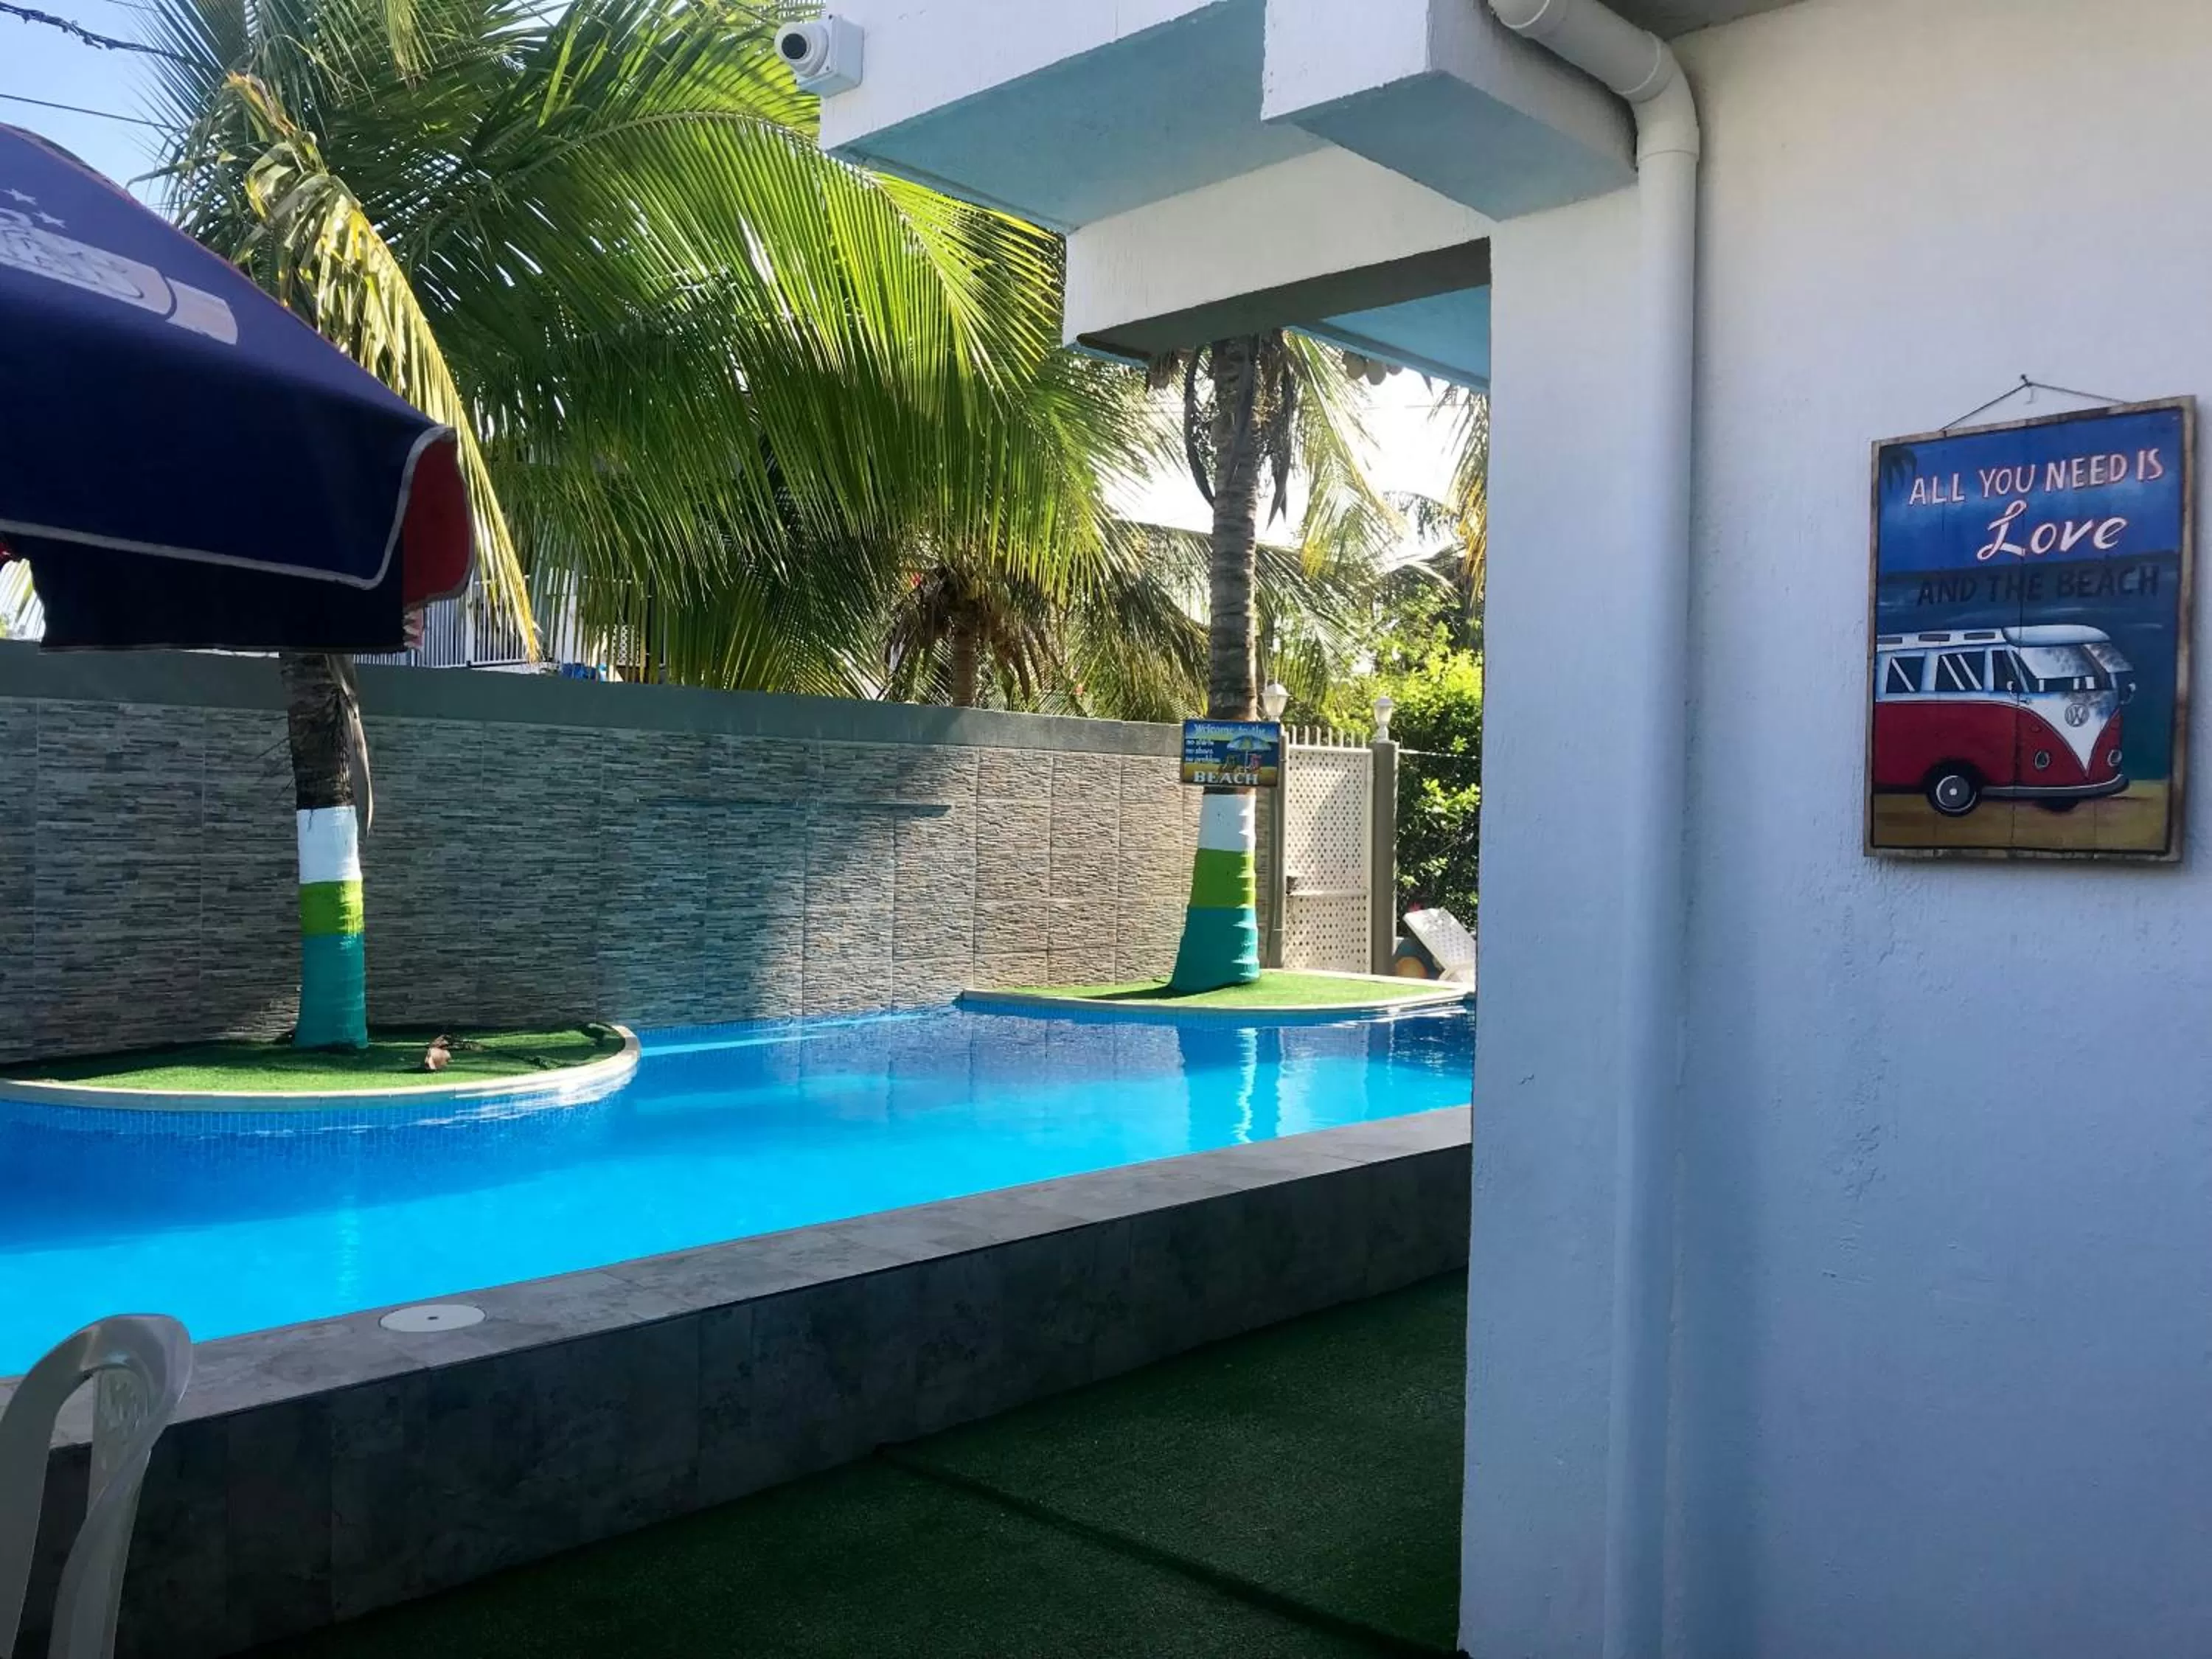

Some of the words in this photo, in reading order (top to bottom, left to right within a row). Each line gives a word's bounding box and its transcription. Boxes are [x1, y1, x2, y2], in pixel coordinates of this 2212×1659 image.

[1907, 472, 1966, 507] ALL
[1978, 463, 2037, 498] YOU
[2044, 452, 2129, 493] NEED
[2137, 447, 2165, 481] IS
[1976, 498, 2129, 560] Love
[1916, 576, 1978, 606] AND
[1989, 570, 2045, 603] THE
[2056, 563, 2160, 599] BEACH
[1193, 723, 1235, 737] Welcome
[1193, 771, 1259, 785] BEACH
